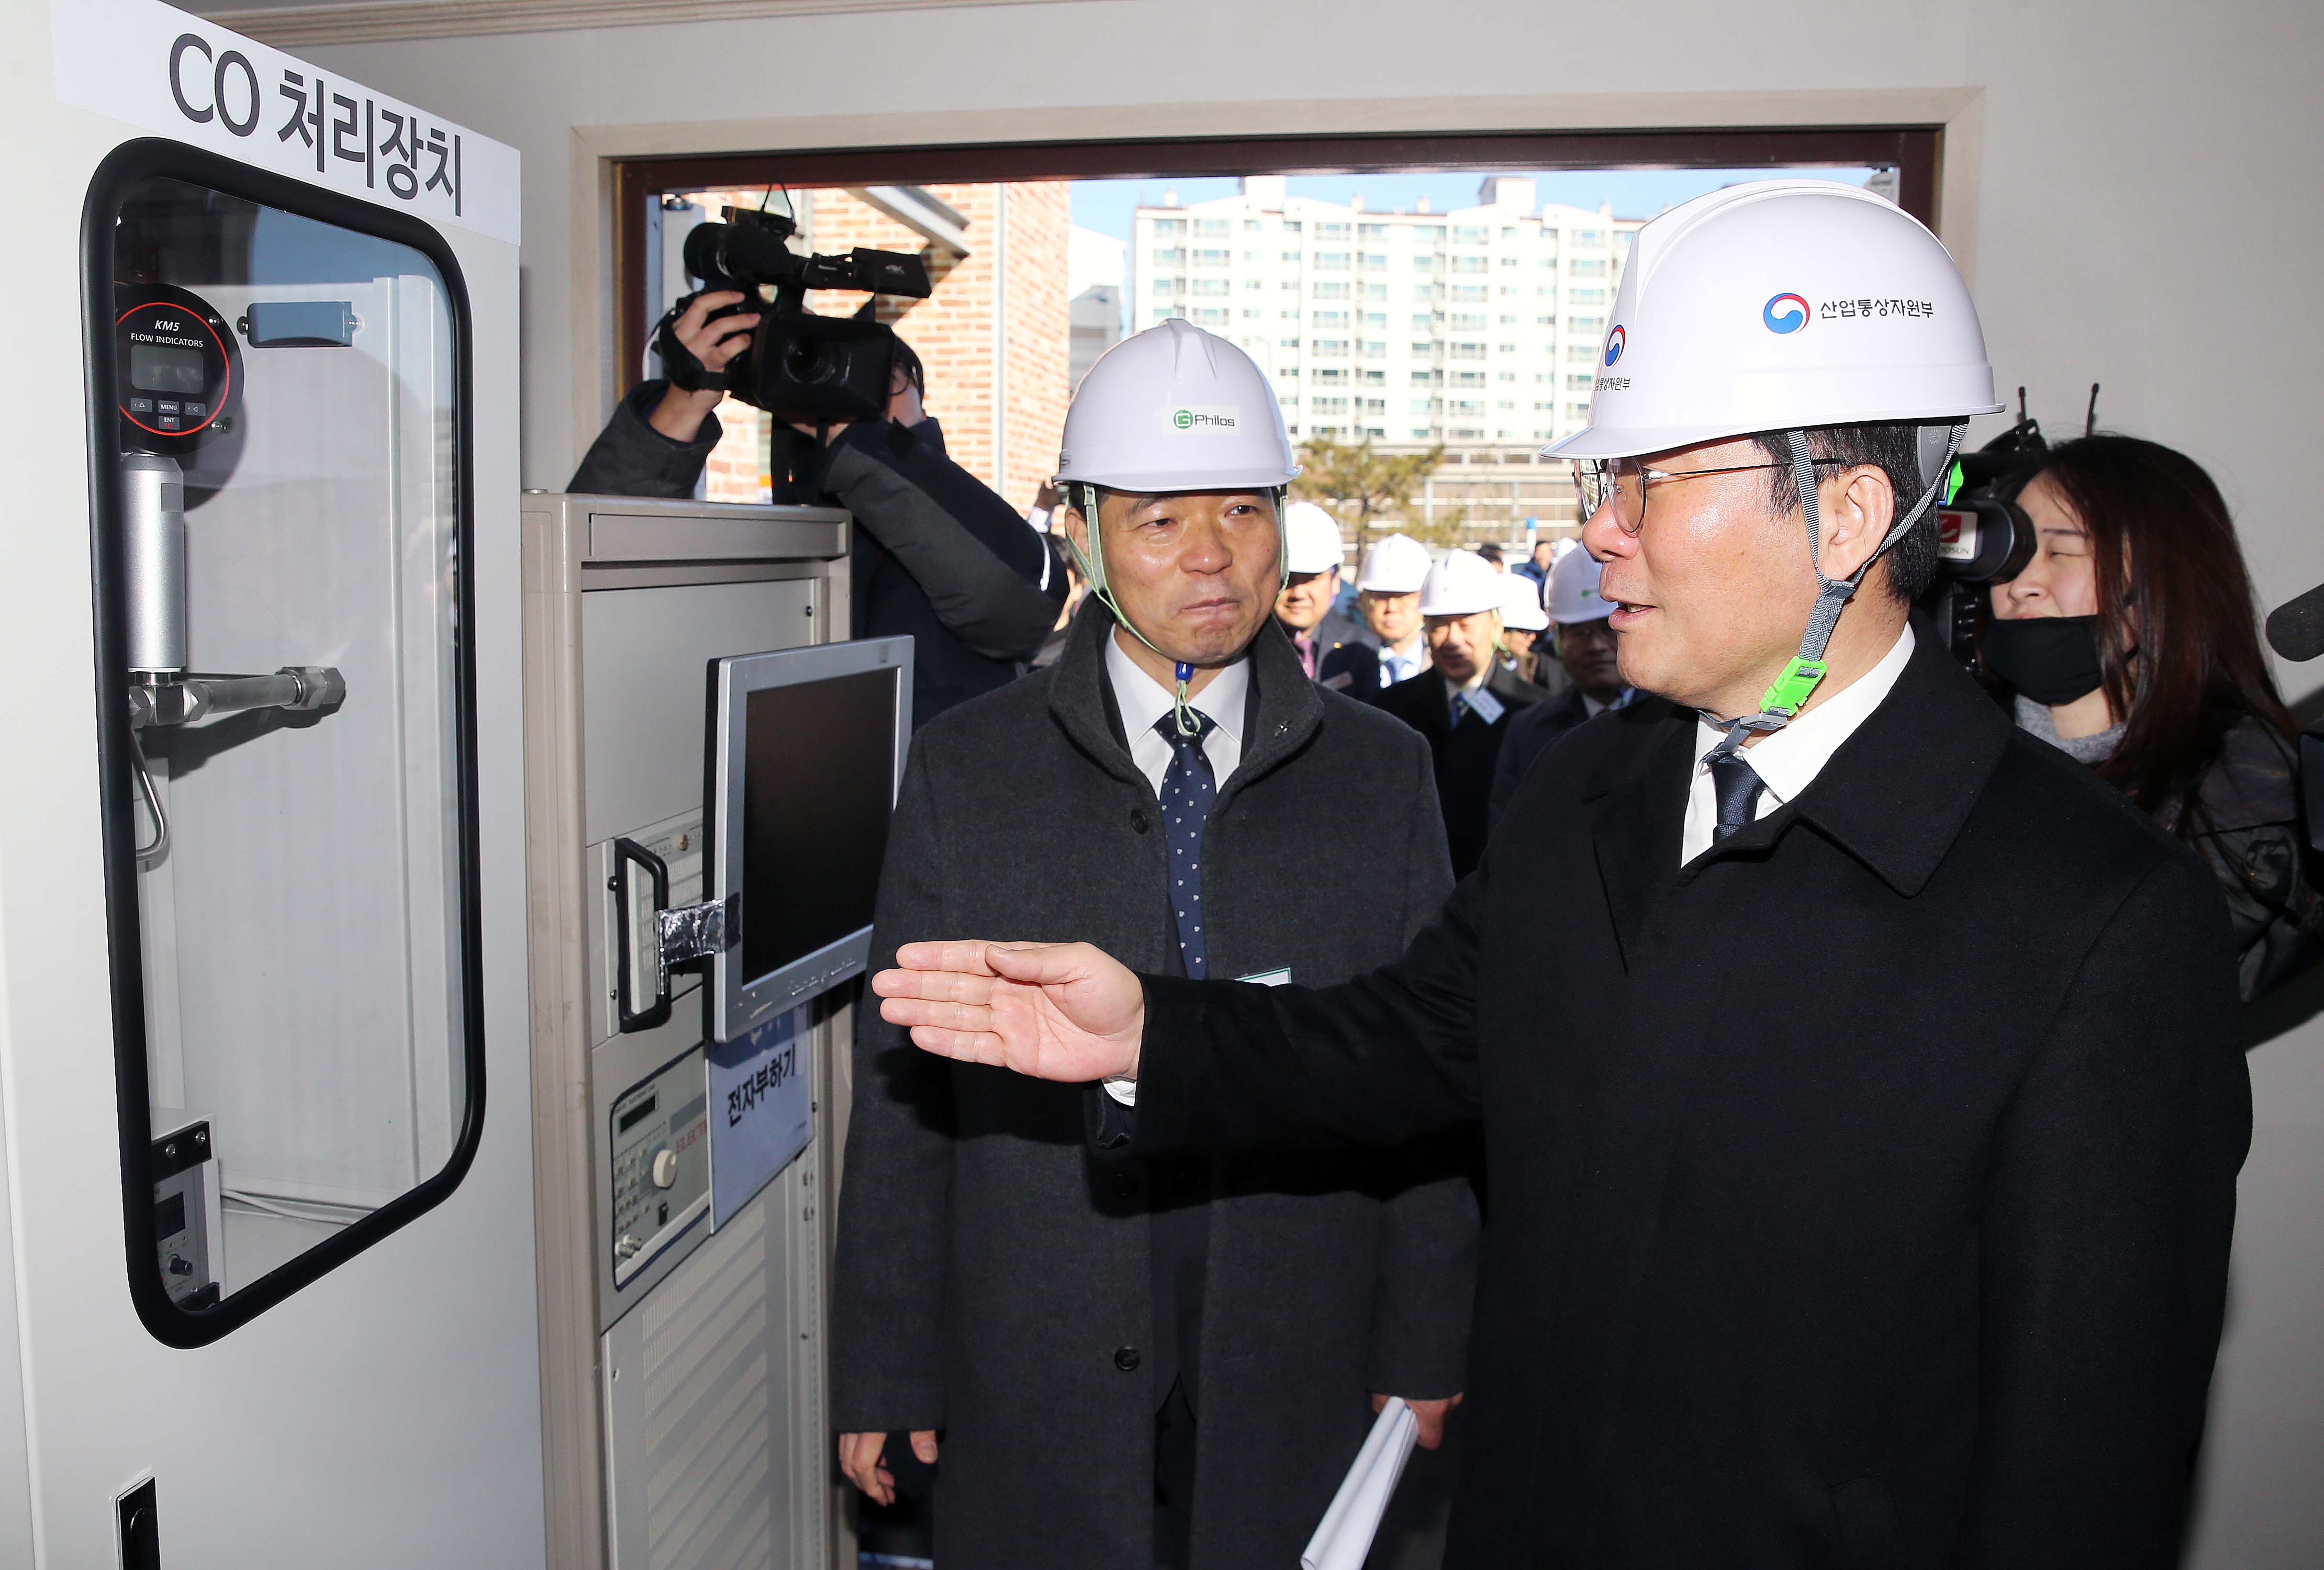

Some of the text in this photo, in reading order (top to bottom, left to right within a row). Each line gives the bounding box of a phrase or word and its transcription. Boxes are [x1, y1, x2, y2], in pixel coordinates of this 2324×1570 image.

[169, 33, 461, 217] CO 처리장치
[1820, 299, 1934, 319] 산업통상자원부
[154, 320, 180, 331] KM5
[131, 333, 203, 347] FLOW INDICATORS
[1593, 377, 1630, 391] 업통상자원부
[728, 1042, 796, 1127] 전자부하기
